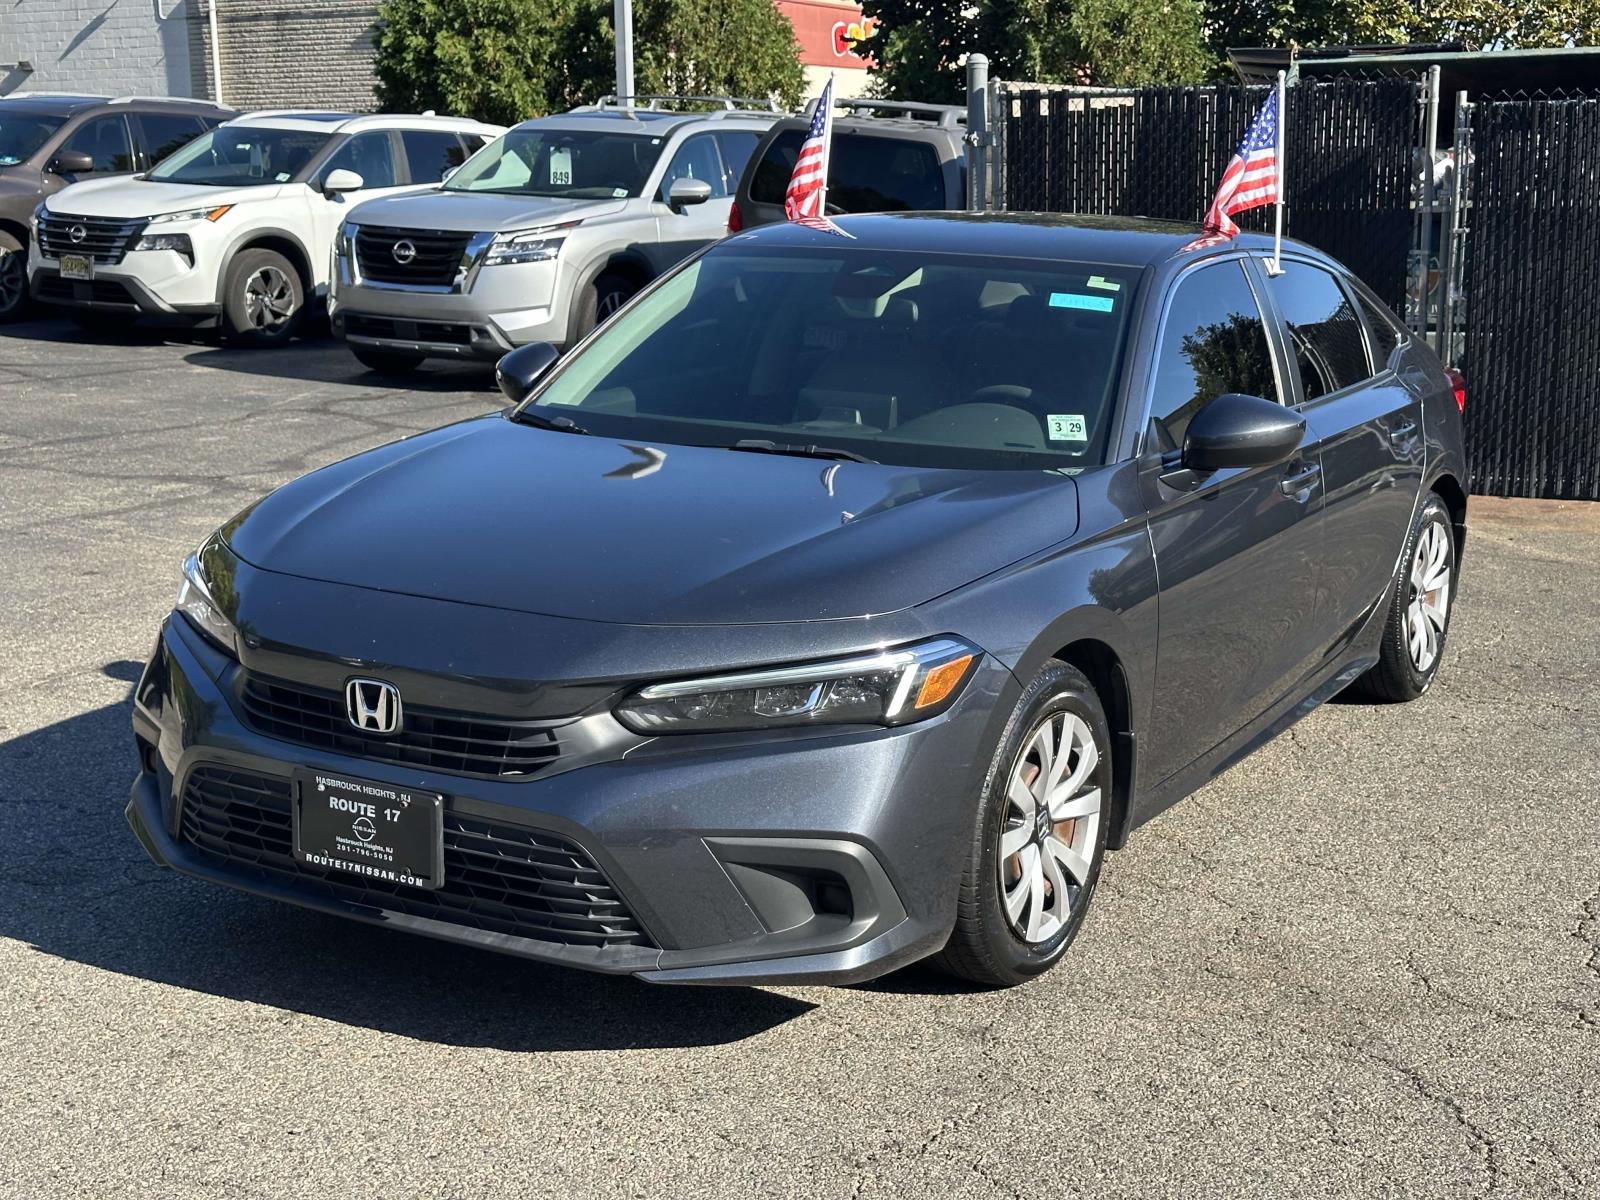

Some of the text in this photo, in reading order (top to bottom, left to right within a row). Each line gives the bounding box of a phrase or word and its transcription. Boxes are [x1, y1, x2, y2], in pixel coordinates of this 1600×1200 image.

[552, 171, 570, 185] 849
[1054, 421, 1082, 433] 3 29
[315, 775, 362, 793] HASBROUCK
[400, 793, 411, 803] NJ
[329, 796, 401, 823] ROUTE 17
[352, 824, 377, 834] NISSAN
[335, 835, 363, 847] Hasbrouck
[385, 846, 394, 854] NJ
[306, 853, 423, 887] ROUTE17NISSAN.COM
